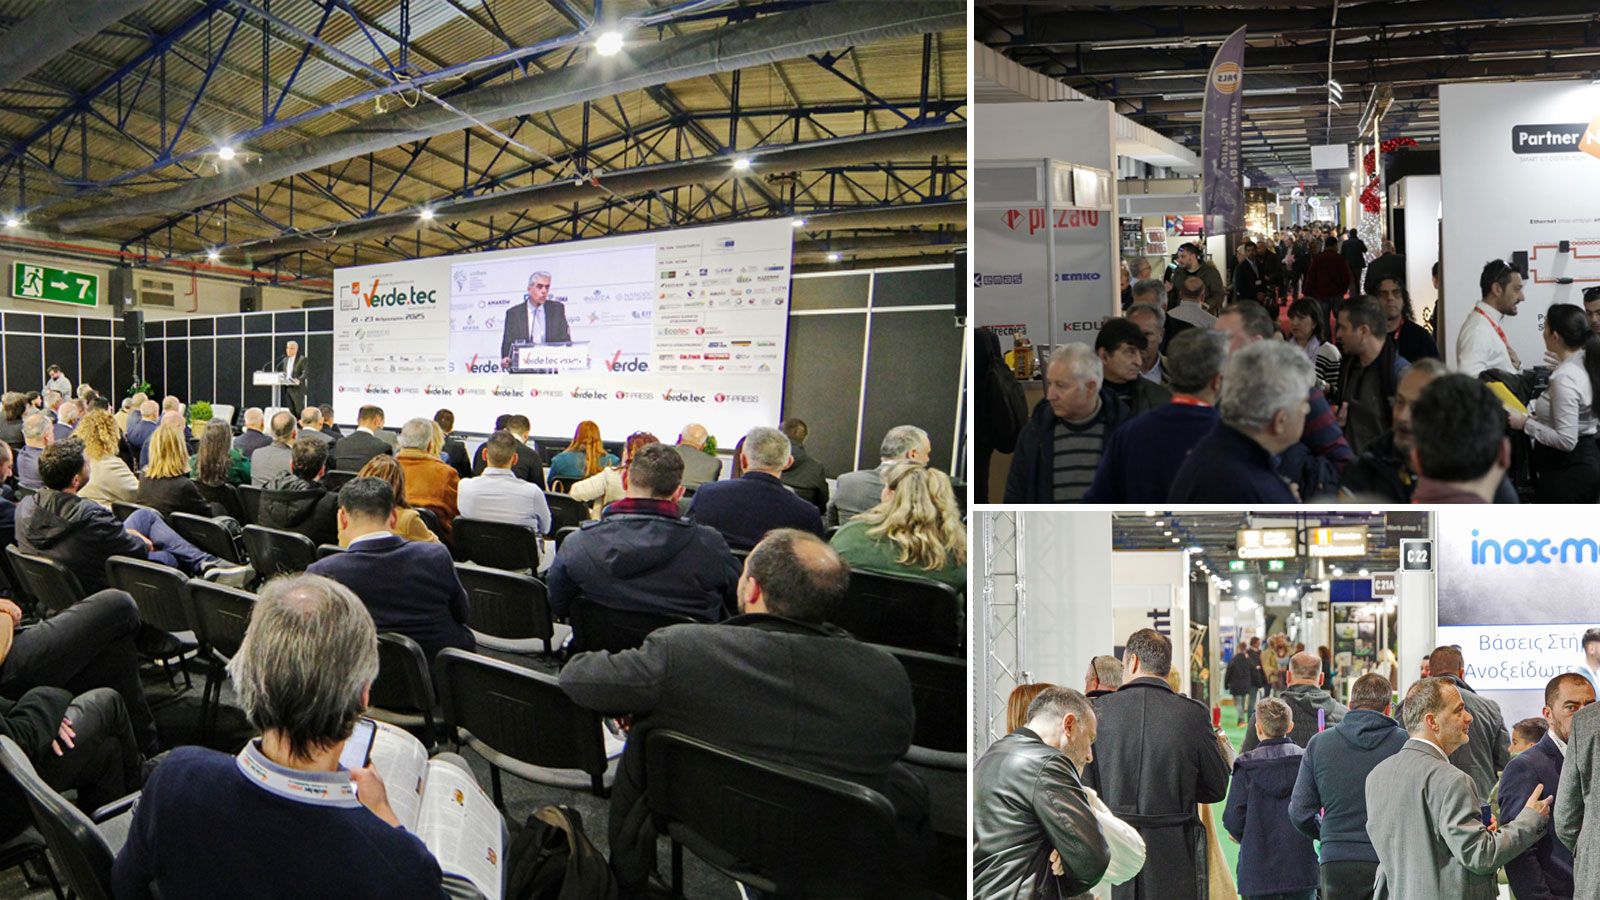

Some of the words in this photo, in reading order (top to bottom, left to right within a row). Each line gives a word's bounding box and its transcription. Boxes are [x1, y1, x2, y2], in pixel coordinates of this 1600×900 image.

[1519, 131, 1580, 146] Partner
[1061, 272, 1101, 282] EMKO
[76, 277, 91, 299] 7
[363, 278, 436, 309] Verde.tec
[1407, 549, 1414, 562] C
[1415, 548, 1428, 561] 22
[1479, 633, 1544, 653] Βάσεις
